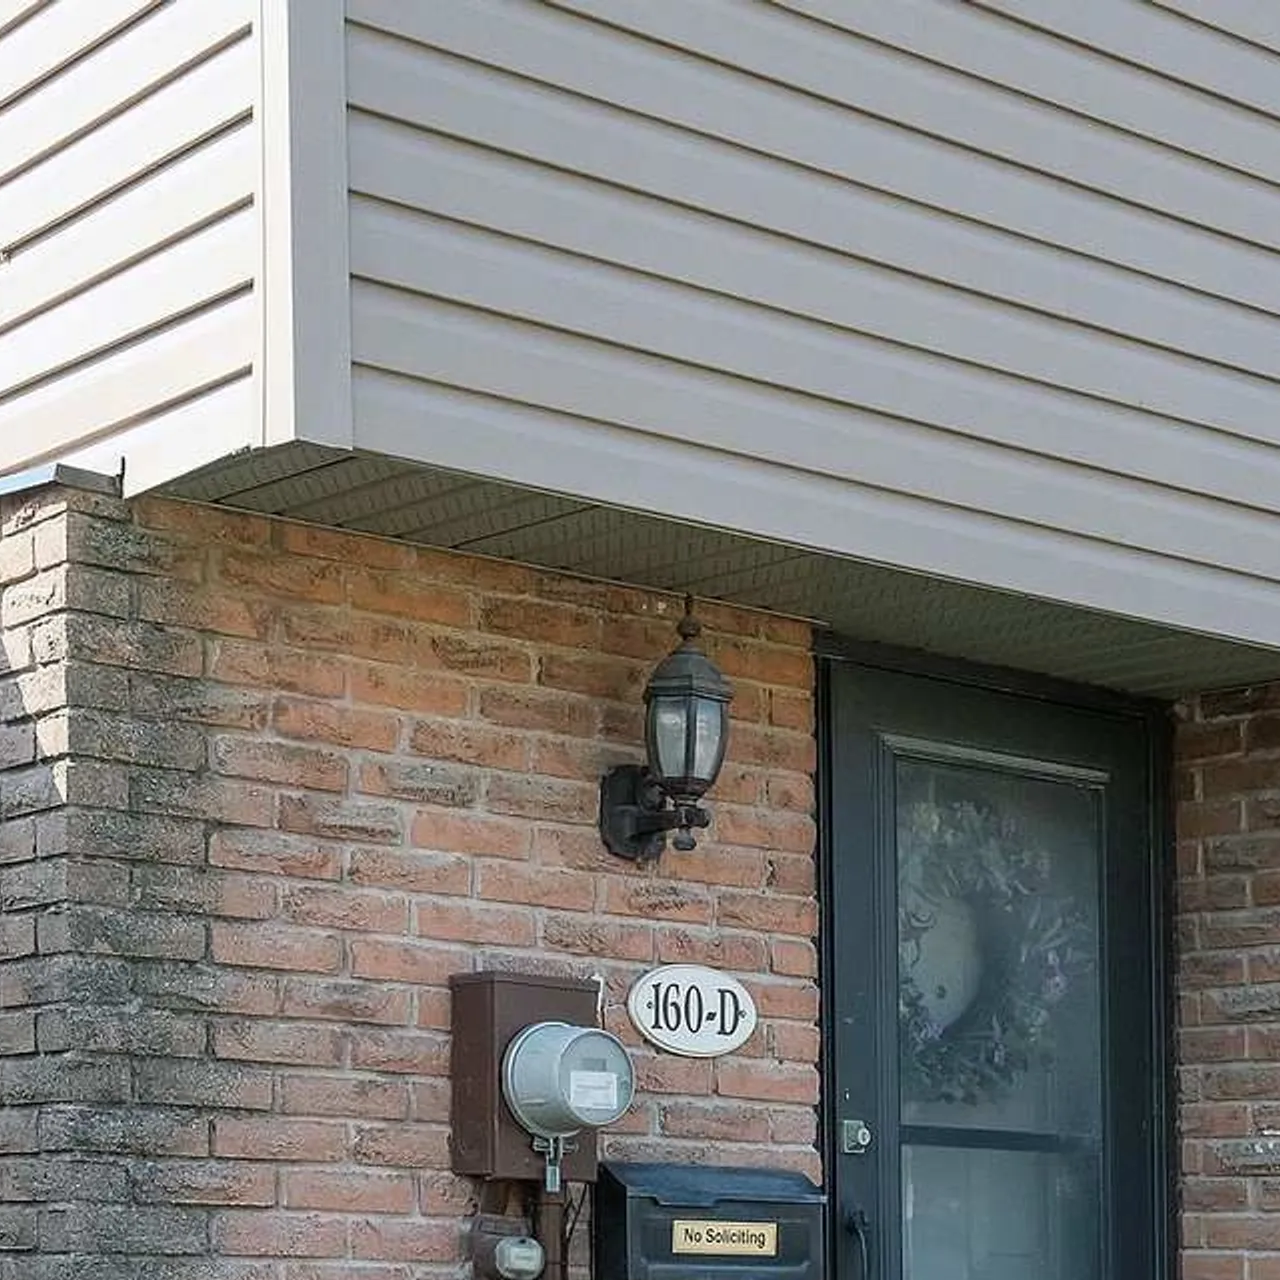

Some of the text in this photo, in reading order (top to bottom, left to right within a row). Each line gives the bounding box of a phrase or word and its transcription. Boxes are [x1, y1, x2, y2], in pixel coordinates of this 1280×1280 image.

[650, 982, 740, 1036] 160-D
[684, 1228, 766, 1250] No Soliciting
